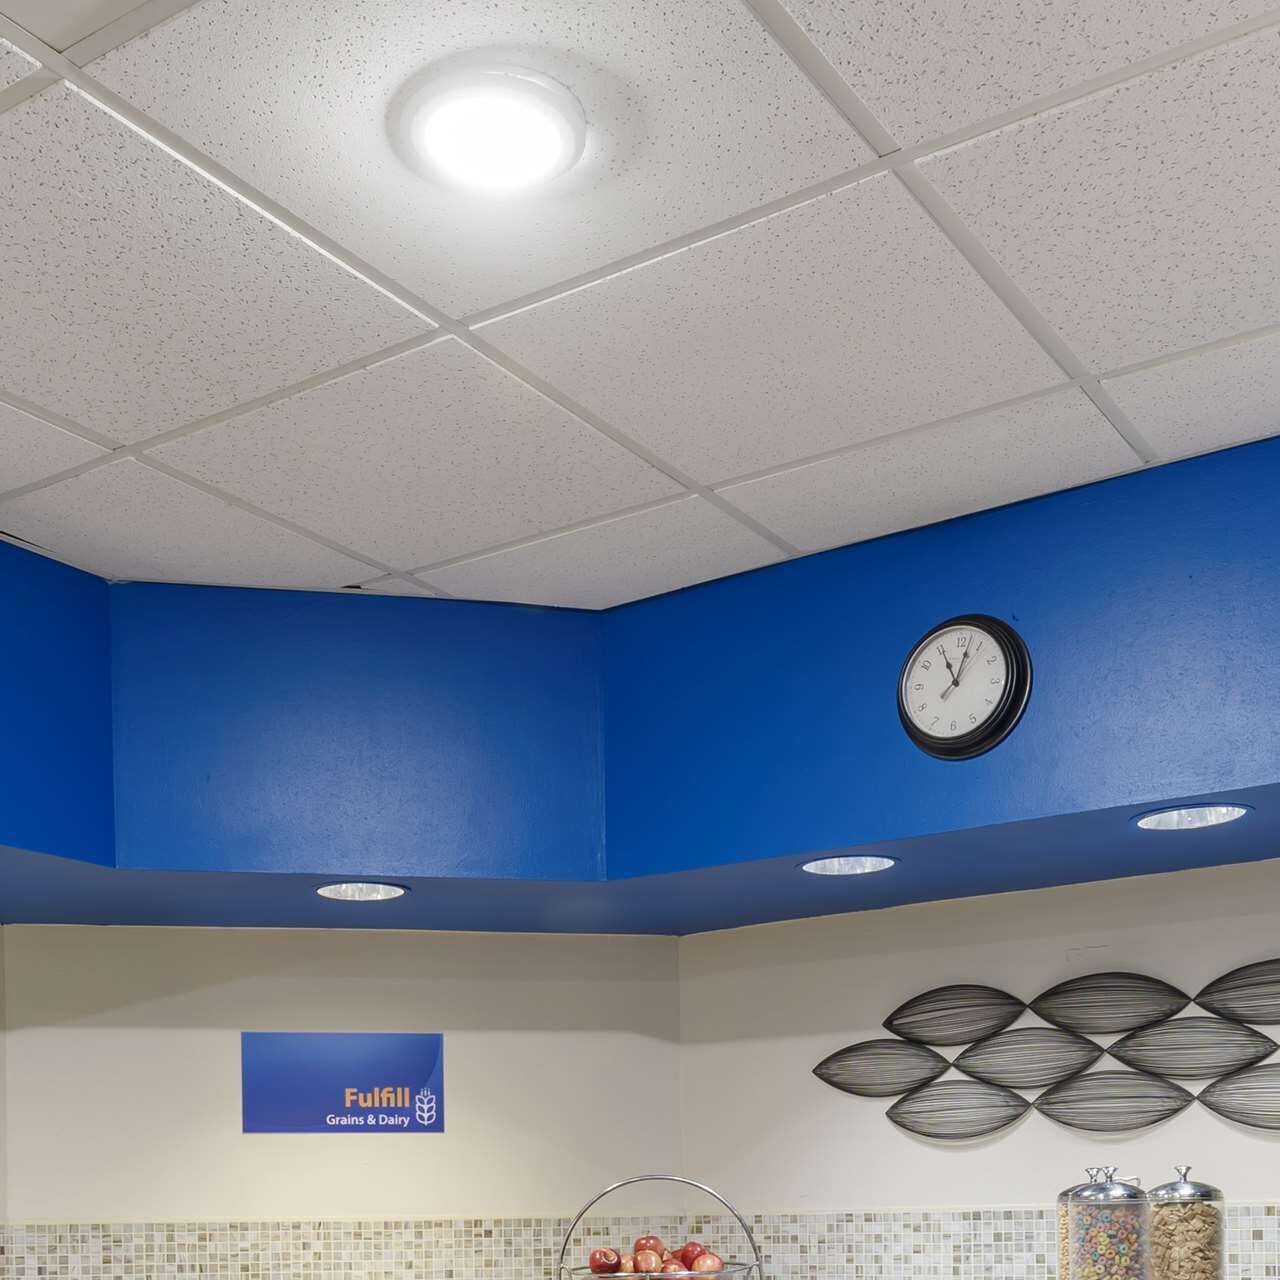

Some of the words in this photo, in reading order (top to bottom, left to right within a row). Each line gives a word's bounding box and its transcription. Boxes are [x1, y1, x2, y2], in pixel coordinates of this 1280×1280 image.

[956, 637, 966, 648] 12
[921, 660, 932, 671] 10
[986, 656, 998, 665] 2
[914, 683, 924, 691] 9
[918, 703, 927, 712] 8
[930, 716, 940, 726] 7
[970, 713, 977, 724] 5
[950, 720, 958, 731] 6
[344, 1087, 410, 1108] Fulfill
[326, 1114, 364, 1126] Grains
[367, 1114, 376, 1126] &
[379, 1114, 410, 1128] Dairy
